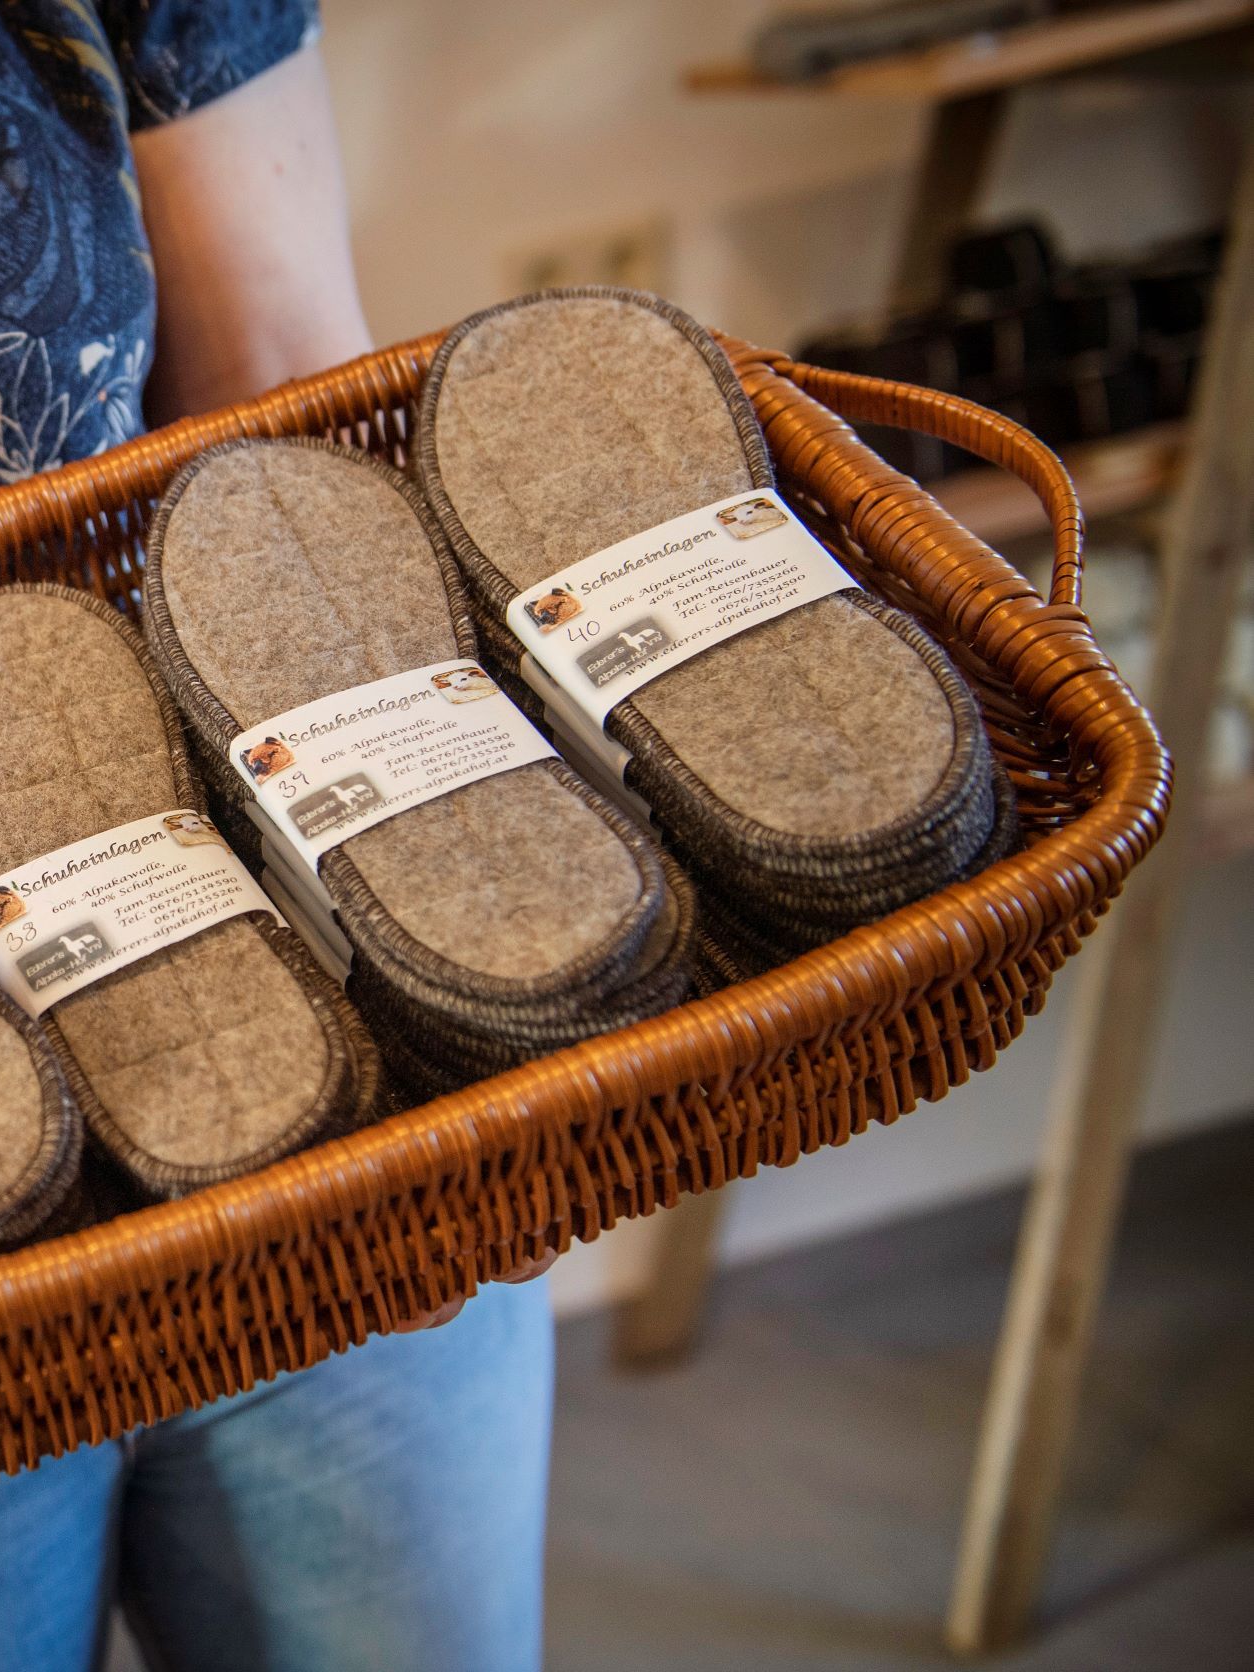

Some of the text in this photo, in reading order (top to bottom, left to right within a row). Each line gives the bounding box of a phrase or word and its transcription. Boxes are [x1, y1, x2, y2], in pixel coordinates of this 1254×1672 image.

[580, 528, 717, 596] Schuheinlagen
[609, 557, 725, 612] 60% Alpakawolle,
[649, 557, 747, 606] 40% Schafwolle
[671, 556, 789, 611] Fam.Reisenbauer
[711, 564, 798, 604] 0676/7355266
[717, 574, 806, 614] 0676/5134590
[567, 621, 600, 645] 40
[624, 588, 800, 677] www.ederers-alpakahof.at
[289, 688, 436, 748] Schuheinlagen
[361, 720, 459, 759] 40% Schafwolle
[321, 719, 436, 764] 60% Alpakawolle,
[384, 723, 500, 769] Fam.Reisenbauer
[421, 732, 510, 767] 0676/5134590
[426, 741, 516, 776] 0676/7355266
[279, 771, 310, 799] 39
[335, 754, 509, 831] www.ederers-alpakahof.at
[20, 830, 166, 898] Schuheinlagen
[91, 863, 187, 908] 40% Schafwolle
[52, 861, 166, 914] 60% Alpakawolle,
[114, 867, 228, 919] Fam.Reisenbauer
[149, 877, 238, 915] 0676/5134590
[154, 886, 242, 925] 0676/7355266
[7, 922, 37, 952] 38
[63, 898, 236, 983] www.ederers-alpakahof.at
